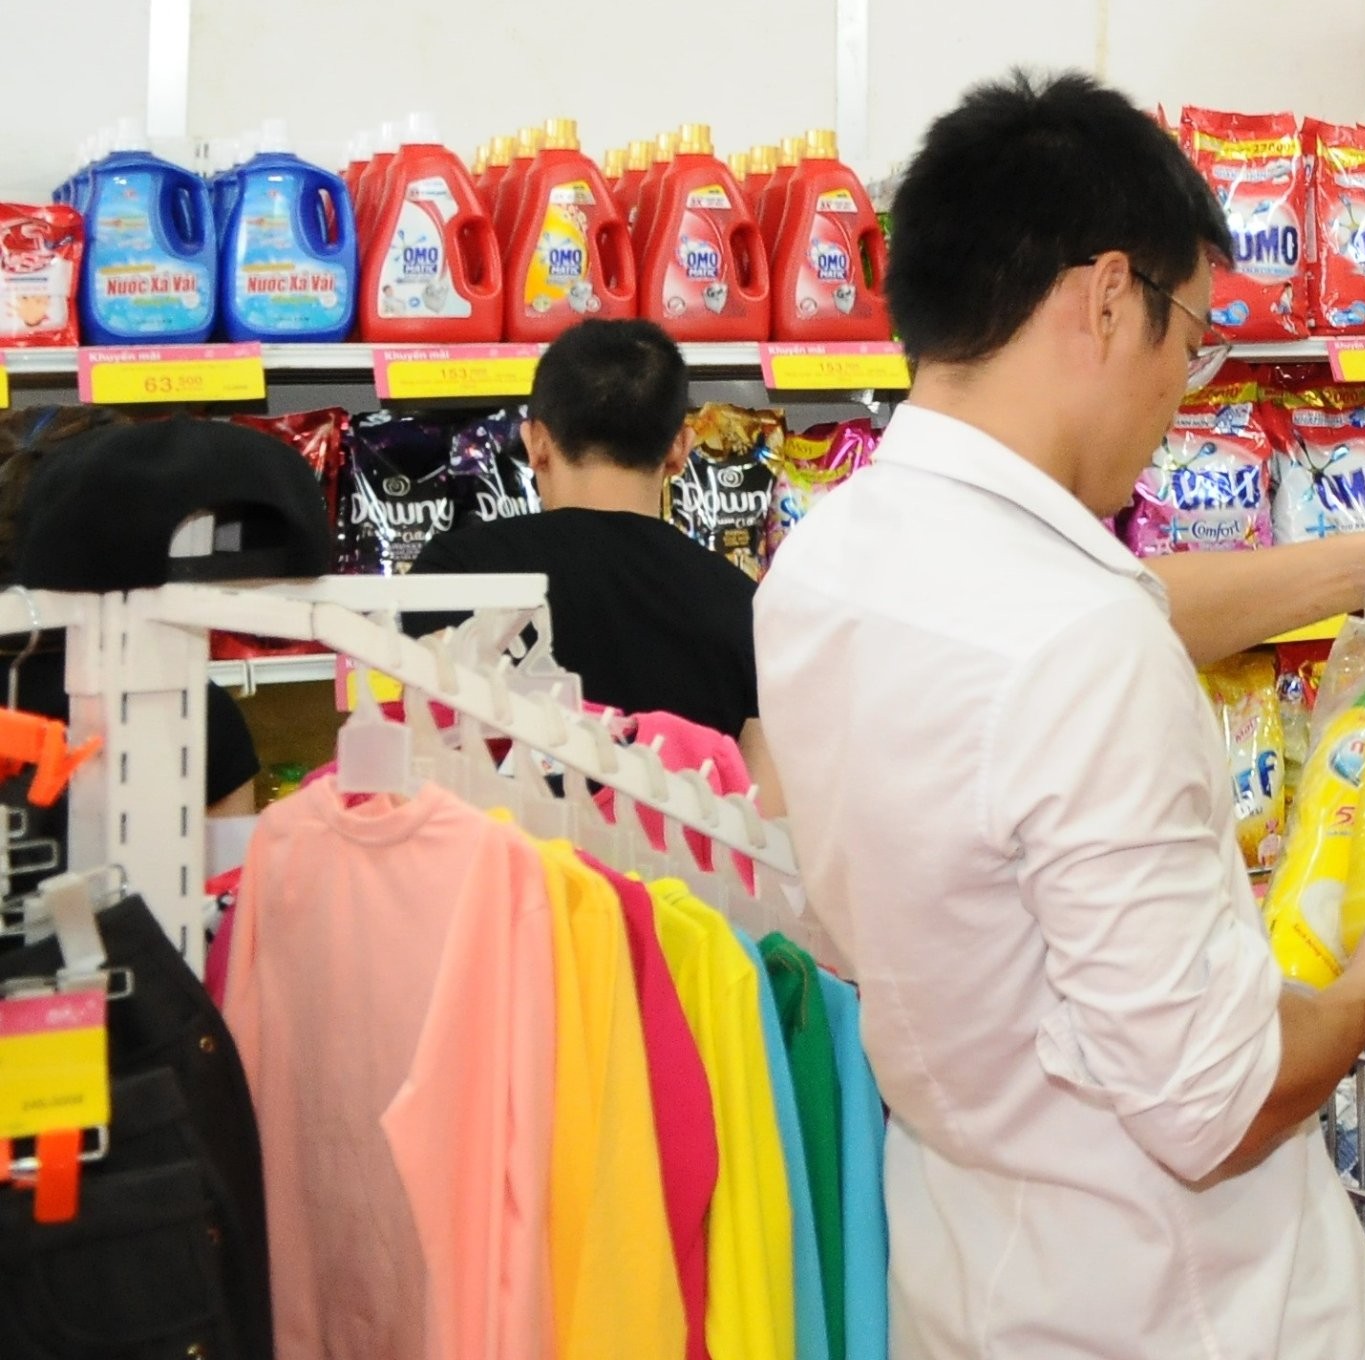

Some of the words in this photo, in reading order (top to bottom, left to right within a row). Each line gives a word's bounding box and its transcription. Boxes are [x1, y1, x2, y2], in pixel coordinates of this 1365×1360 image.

[403, 247, 439, 265] OMO
[549, 248, 583, 266] OMO
[687, 251, 719, 268] OMO
[818, 252, 847, 269] OMO
[403, 264, 438, 275] MATIC
[549, 264, 582, 276] MATIC
[351, 492, 455, 532] Downy
[1191, 520, 1241, 539] Comfort
